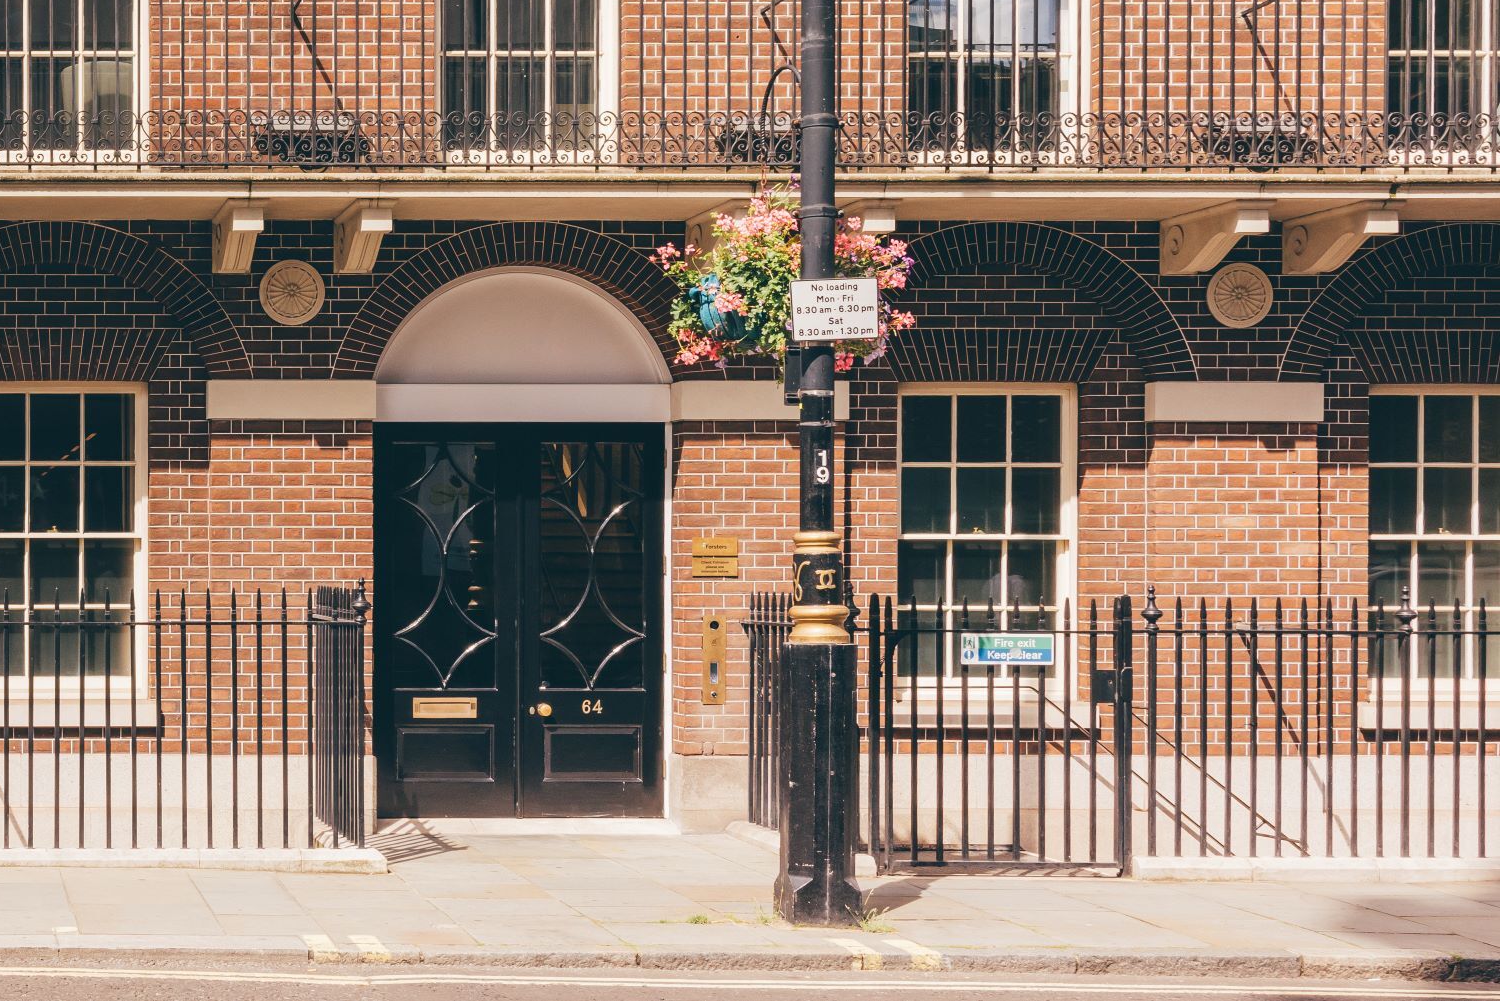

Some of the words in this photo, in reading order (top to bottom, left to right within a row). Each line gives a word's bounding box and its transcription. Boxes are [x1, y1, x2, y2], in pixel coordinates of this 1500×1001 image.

[811, 284, 824, 292] No
[826, 283, 858, 292] loading
[816, 295, 835, 303] Mon
[842, 294, 854, 302] Fri
[796, 306, 817, 315] 8.30
[838, 304, 860, 313] 6.30
[861, 305, 875, 313] pm
[828, 317, 844, 325] Sat
[798, 328, 819, 337] 8.30
[840, 327, 859, 335] 1.30
[860, 327, 874, 336] pm
[994, 638, 1014, 648] Fire
[1017, 638, 1036, 648] exit
[581, 699, 603, 714] 64
